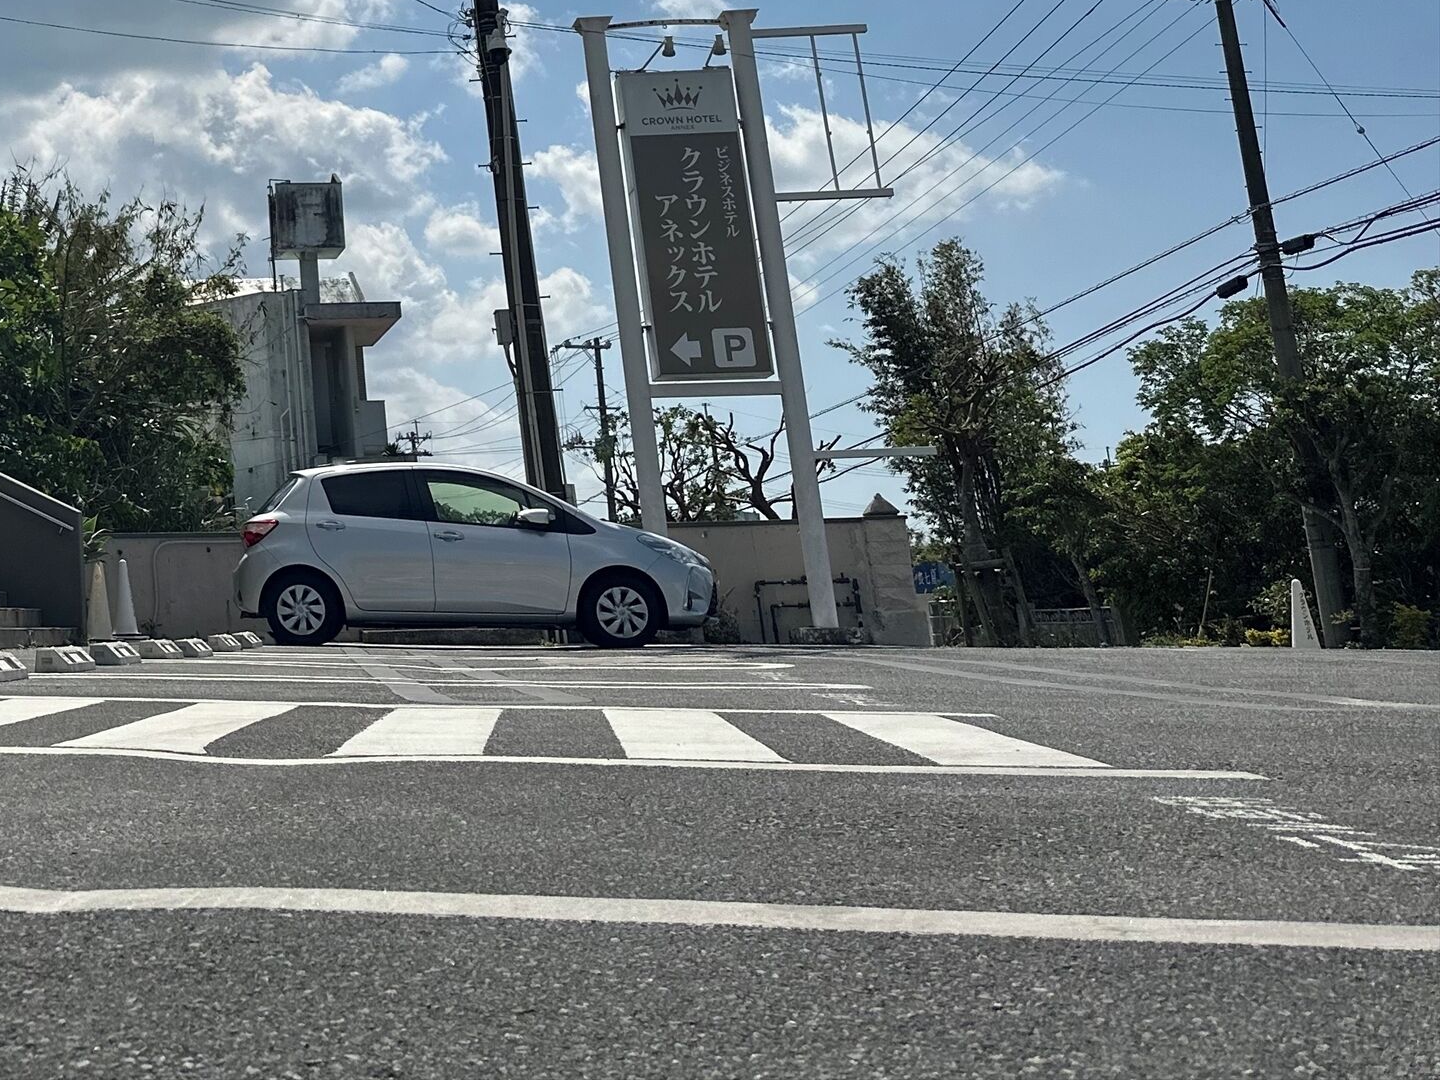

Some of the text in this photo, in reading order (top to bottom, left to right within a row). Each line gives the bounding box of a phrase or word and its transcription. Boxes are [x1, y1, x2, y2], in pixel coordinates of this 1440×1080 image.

[641, 114, 722, 126] CROWN HOTEL
[680, 147, 723, 313] クラウンホテル
[715, 145, 740, 238] ビジネスホテル
[655, 194, 693, 313] アネックス
[723, 334, 747, 362] P
